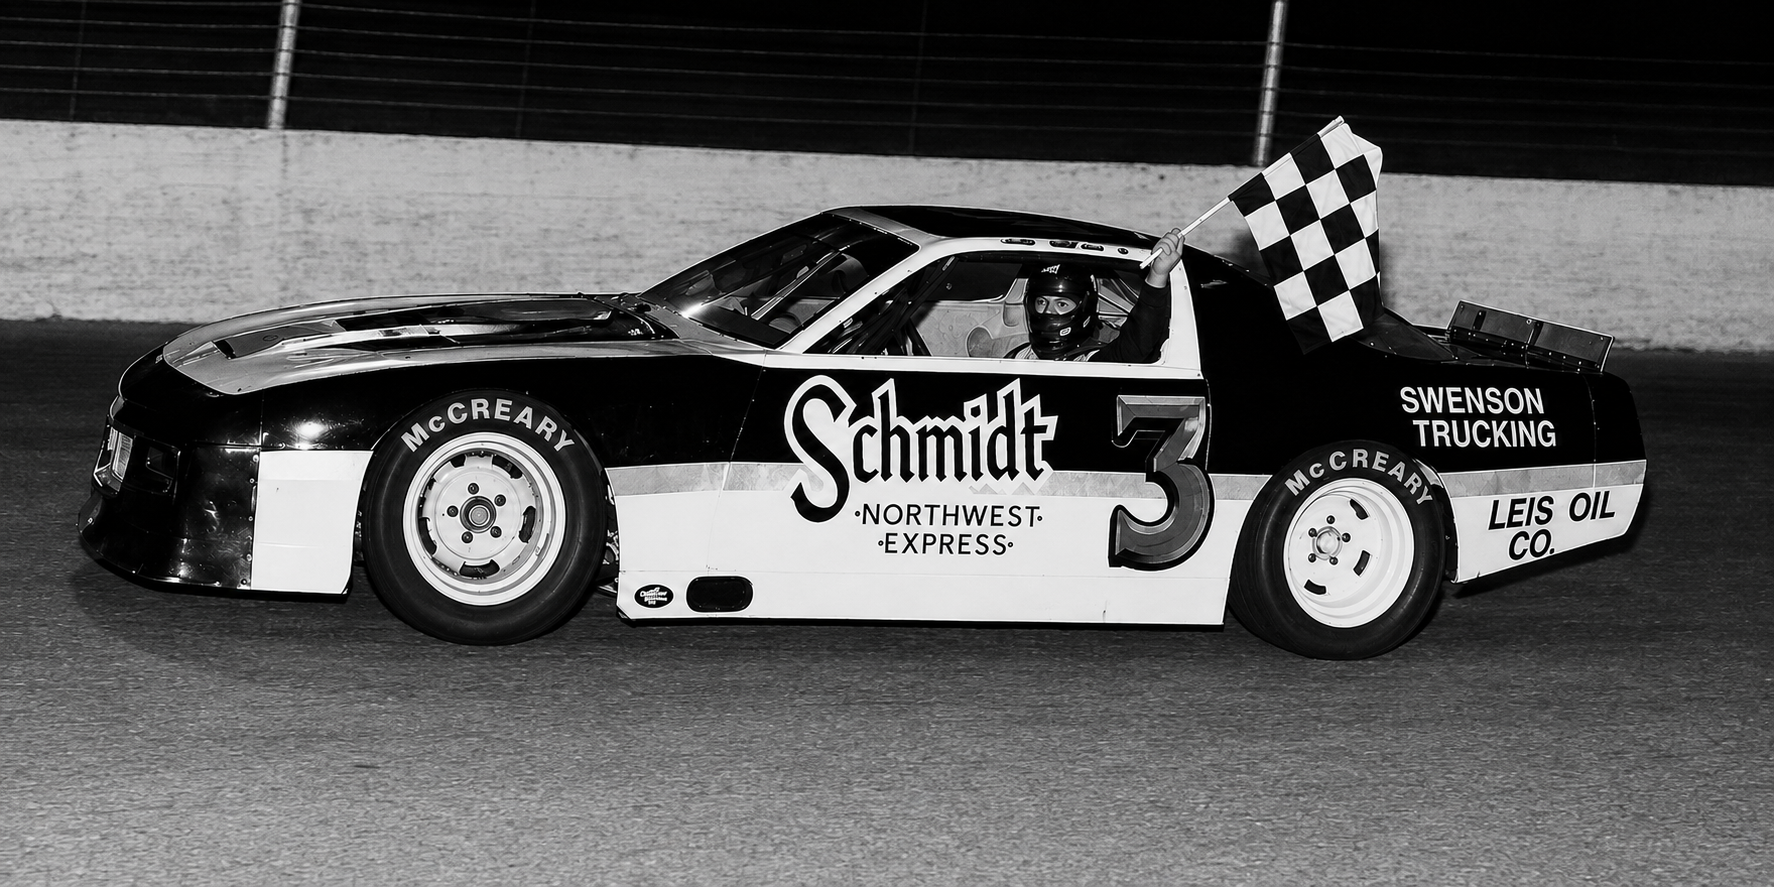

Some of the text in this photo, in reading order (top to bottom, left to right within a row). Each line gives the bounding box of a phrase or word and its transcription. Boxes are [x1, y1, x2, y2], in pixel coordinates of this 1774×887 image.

[1400, 386, 1544, 414] SWENSON
[401, 398, 575, 453] McCREARY
[785, 375, 1058, 522] Schmidt
[1412, 419, 1556, 448] TRUCKING
[1108, 395, 1216, 571] 3
[1285, 448, 1433, 506] McCREARY
[1488, 491, 1616, 531] LEIS OIL
[1508, 528, 1555, 561] CO.
